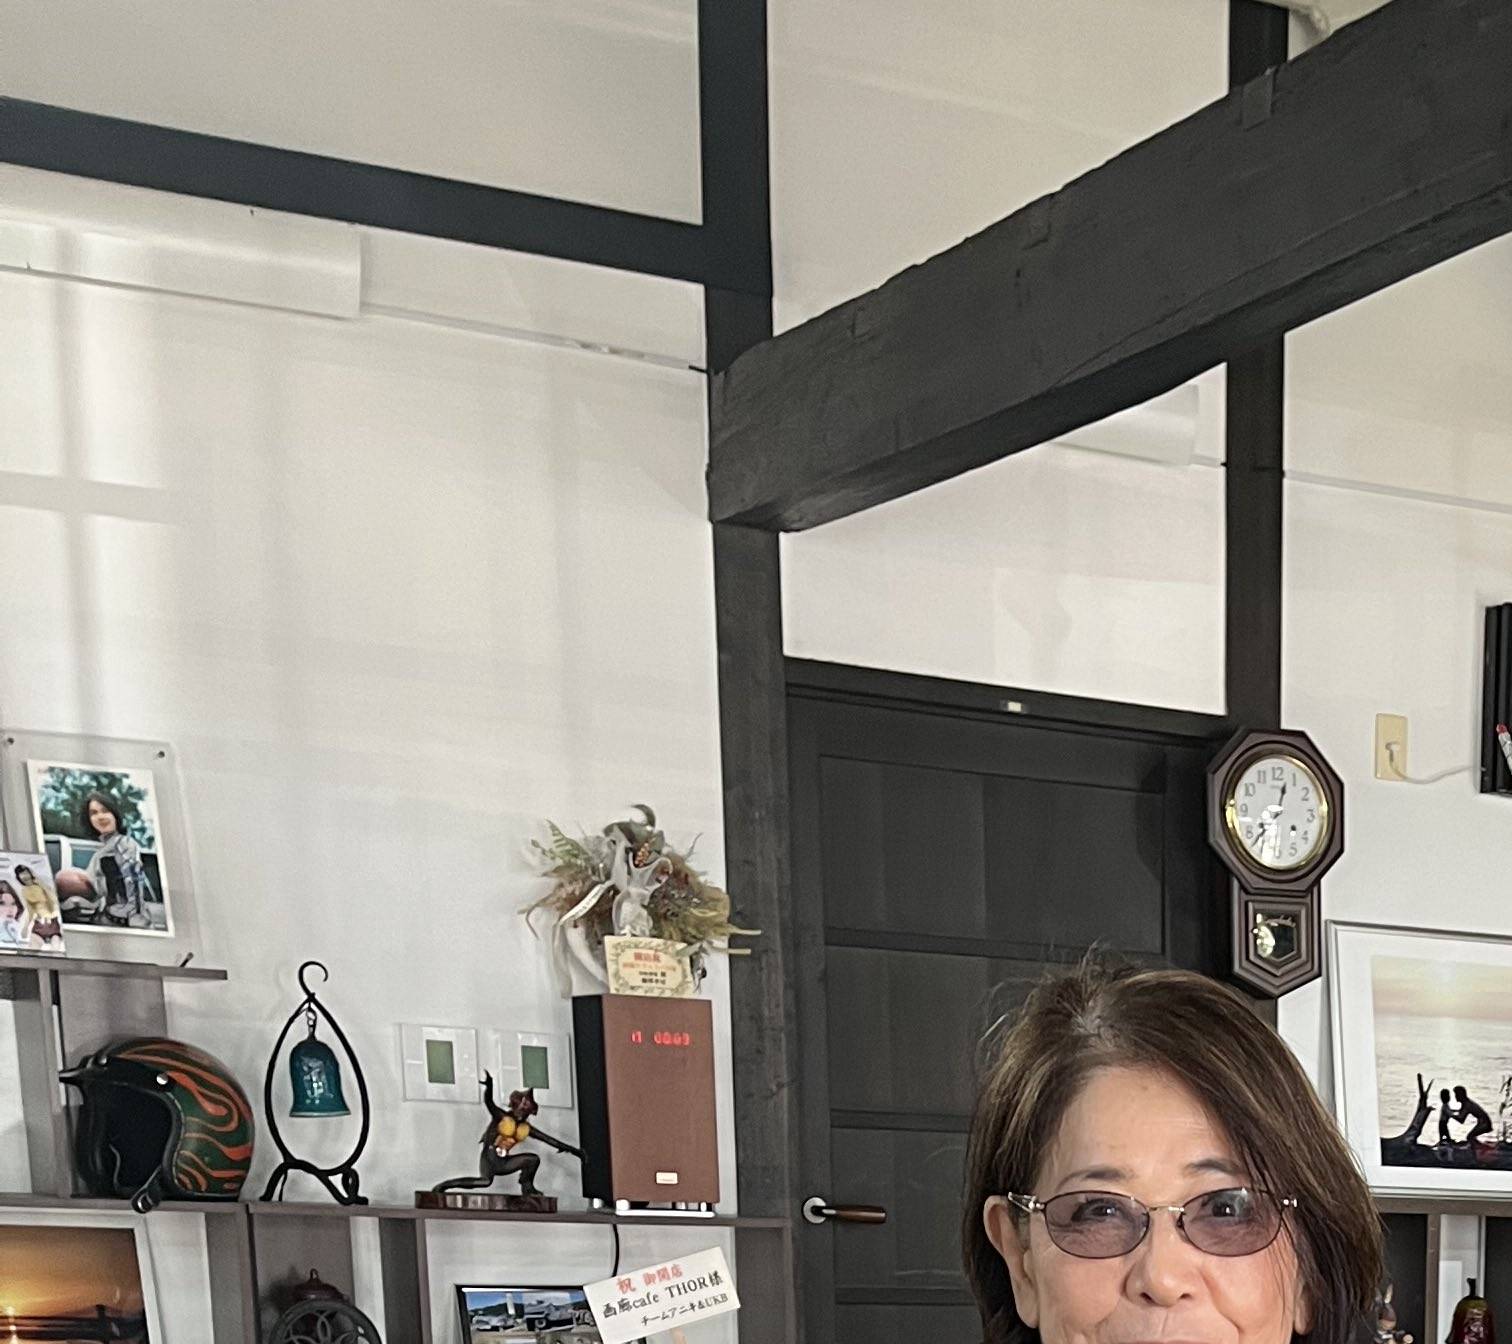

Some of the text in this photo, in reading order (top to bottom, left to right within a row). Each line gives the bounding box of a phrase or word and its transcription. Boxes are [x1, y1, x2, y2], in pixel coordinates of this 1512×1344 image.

[1257, 770, 1267, 784] 11
[1272, 767, 1284, 781] 12
[1291, 772, 1297, 787] 1
[1244, 782, 1256, 797] 10
[1301, 786, 1310, 801] 2
[1240, 803, 1248, 817] 9
[1307, 809, 1315, 823] 3
[1245, 825, 1254, 839] 8
[1301, 830, 1309, 844] 4
[1289, 842, 1297, 857] 5
[616, 1277, 636, 1294] 祝
